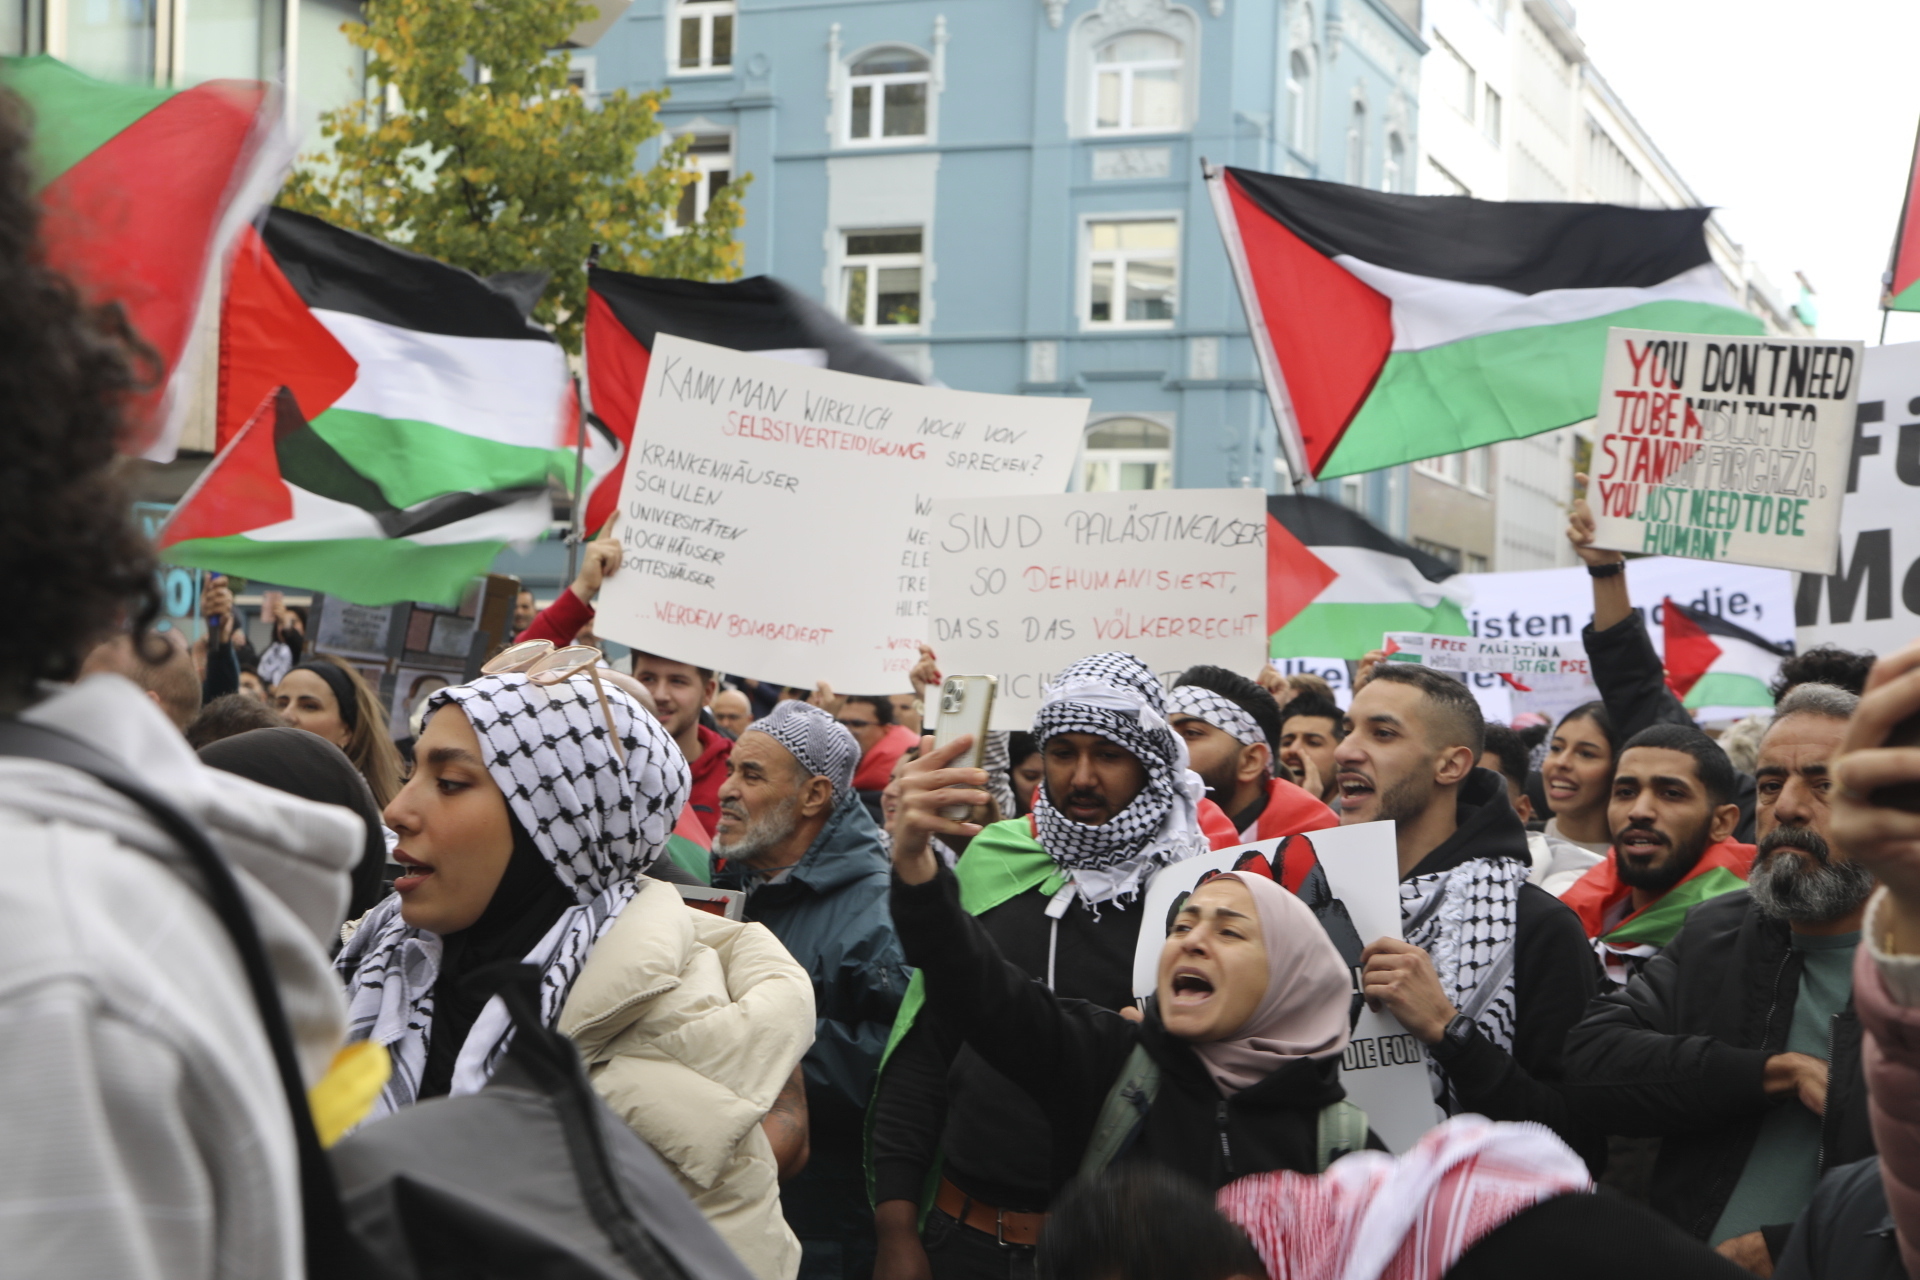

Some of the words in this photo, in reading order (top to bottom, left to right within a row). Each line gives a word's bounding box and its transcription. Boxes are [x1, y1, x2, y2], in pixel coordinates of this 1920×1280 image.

[1624, 339, 1689, 390] YOU
[1702, 342, 1787, 397] DON'T
[1784, 345, 1854, 400] NEED
[659, 355, 725, 405] KANN
[729, 376, 788, 412] MAN
[804, 390, 893, 431] WIRKLICH
[917, 416, 966, 441] NOCH
[984, 424, 1027, 444] VON
[722, 410, 926, 460] SELBSTVERTEIDIGUNG
[1614, 390, 1648, 436] TO
[1649, 391, 1682, 438] BE
[1682, 397, 1776, 447] MUSLIM
[1779, 402, 1818, 450] TO
[640, 439, 800, 493] KRANKENHÄUSER
[945, 451, 1043, 475] SPRECHEN?
[1746, 448, 1828, 499] GAZA,
[634, 470, 722, 506] SCHULEN
[630, 501, 748, 541] UNIVERSITÄTEN
[1598, 480, 1639, 519] YOU
[1637, 485, 1688, 523] JUST
[1688, 489, 1741, 531] NEED
[1742, 493, 1775, 534] TO
[1775, 497, 1810, 537] BE
[906, 527, 931, 546] ME
[940, 512, 1043, 553] SIND
[1064, 504, 1267, 548] PALÄSTINENSER
[1643, 522, 1732, 560] HUMAN!
[969, 567, 1007, 596] SO
[1022, 565, 1238, 595] DEHUMANISIERT,
[727, 614, 834, 646] BOMBADIERT
[934, 617, 1000, 641] DASS
[1022, 616, 1076, 642] DAS
[1093, 607, 1259, 641] VÖLKERRECHT
[1431, 638, 1468, 652] FREE
[1559, 659, 1588, 674] PSE
[1342, 1038, 1378, 1071] DIE
[1378, 1033, 1421, 1066] FOR
